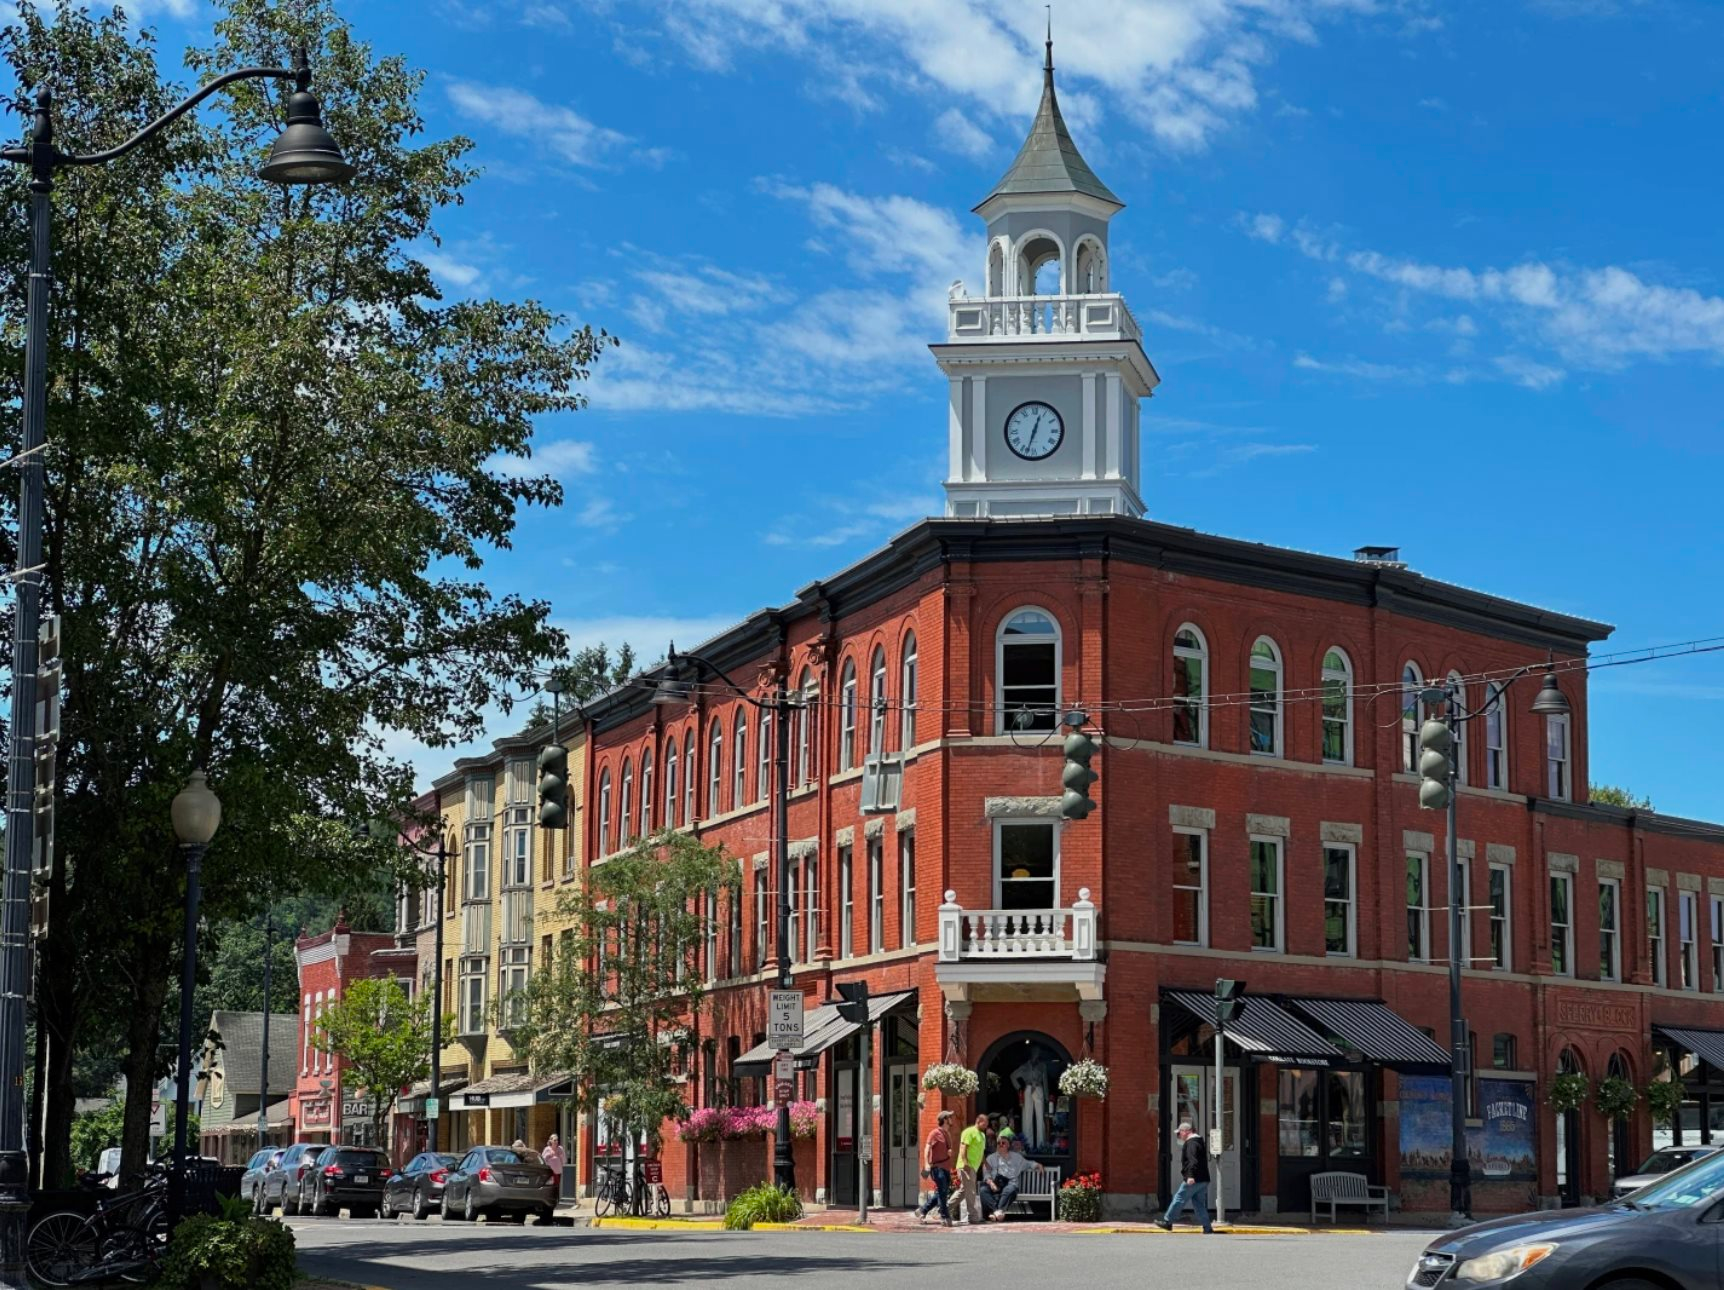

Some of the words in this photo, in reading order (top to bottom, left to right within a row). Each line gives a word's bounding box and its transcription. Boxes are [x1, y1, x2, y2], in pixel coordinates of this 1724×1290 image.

[772, 993, 801, 1001] WEIGHT
[776, 1002, 796, 1010] LIMIT
[783, 1012, 790, 1021] 5
[774, 1023, 799, 1032] TONS
[343, 1103, 368, 1115] BAR
